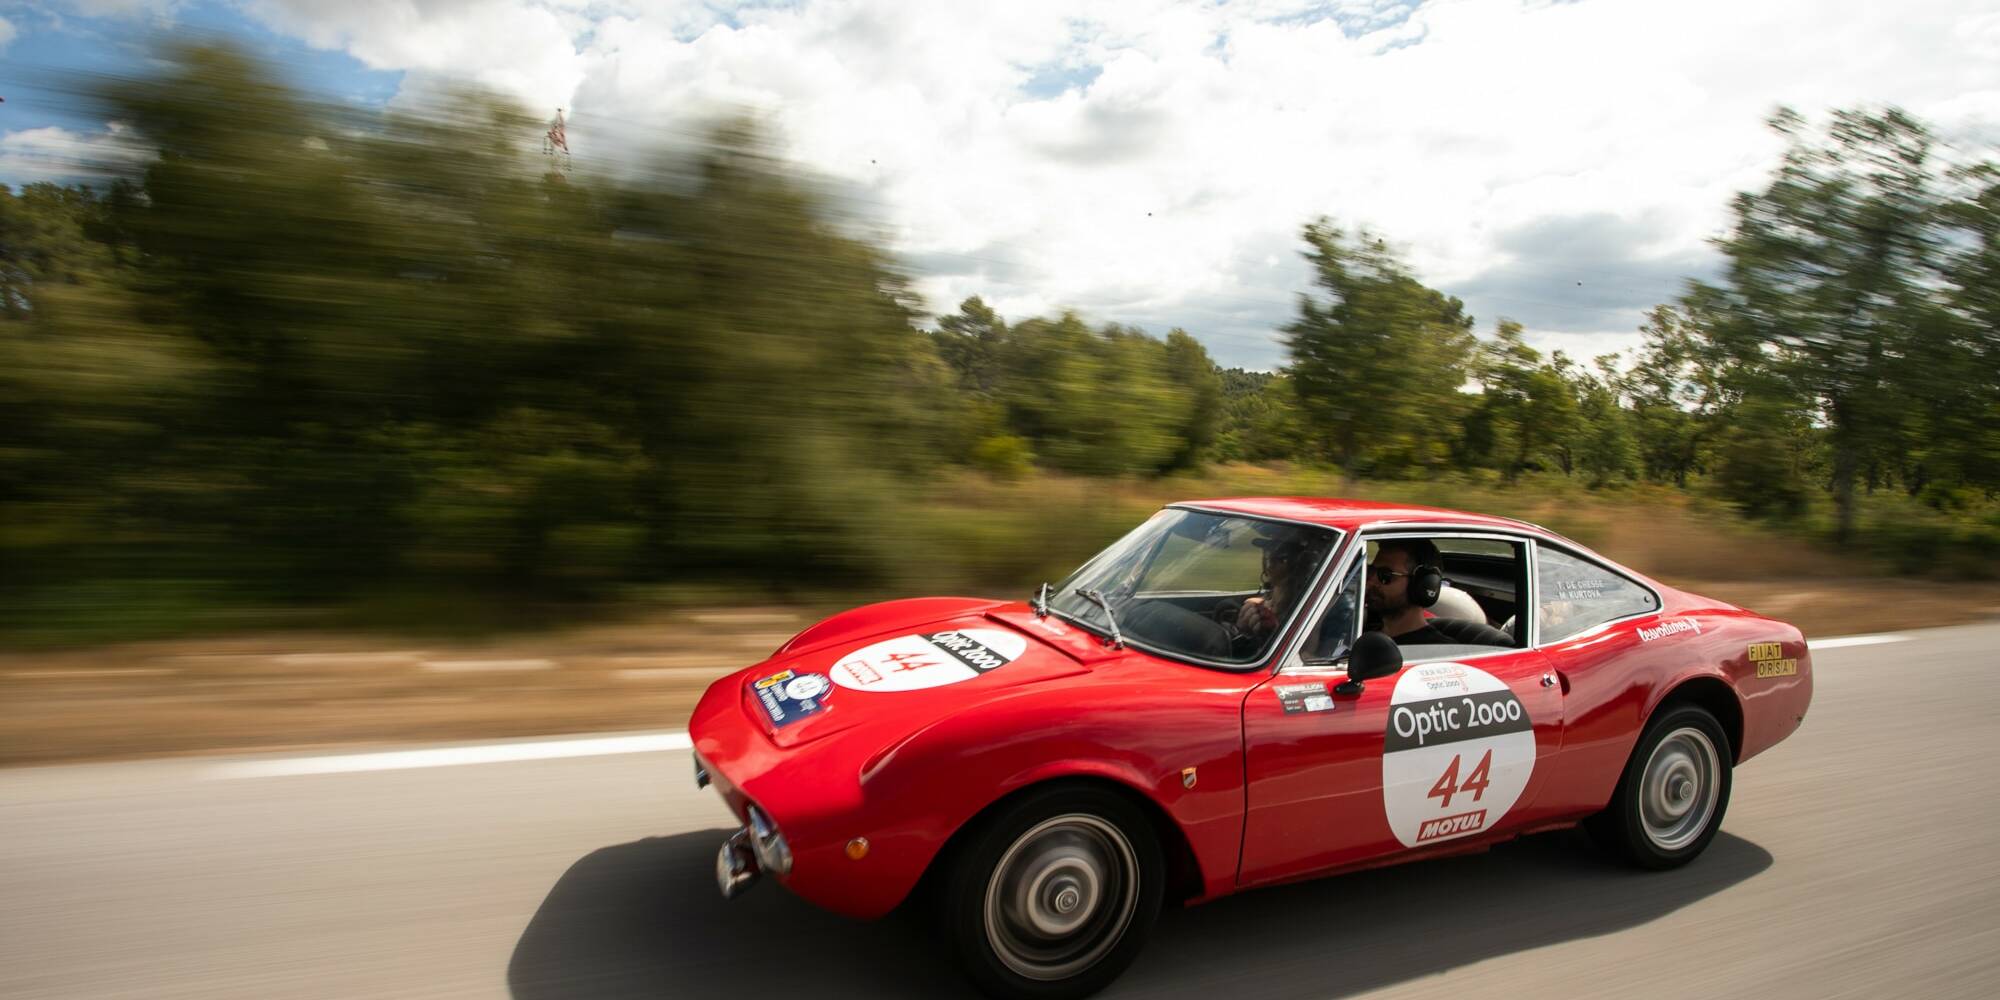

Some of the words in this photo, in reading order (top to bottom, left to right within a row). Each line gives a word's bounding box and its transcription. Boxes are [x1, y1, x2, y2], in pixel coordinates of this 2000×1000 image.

[881, 652, 943, 673] 44
[931, 631, 973, 655] Optic
[959, 645, 1001, 669] 2000
[1750, 644, 1779, 659] FIAT
[1759, 660, 1796, 675] ORSAY
[1393, 701, 1460, 745] Optic
[1462, 698, 1521, 728] 2000
[1427, 749, 1492, 809] 44
[1420, 812, 1481, 840] MOTUL
